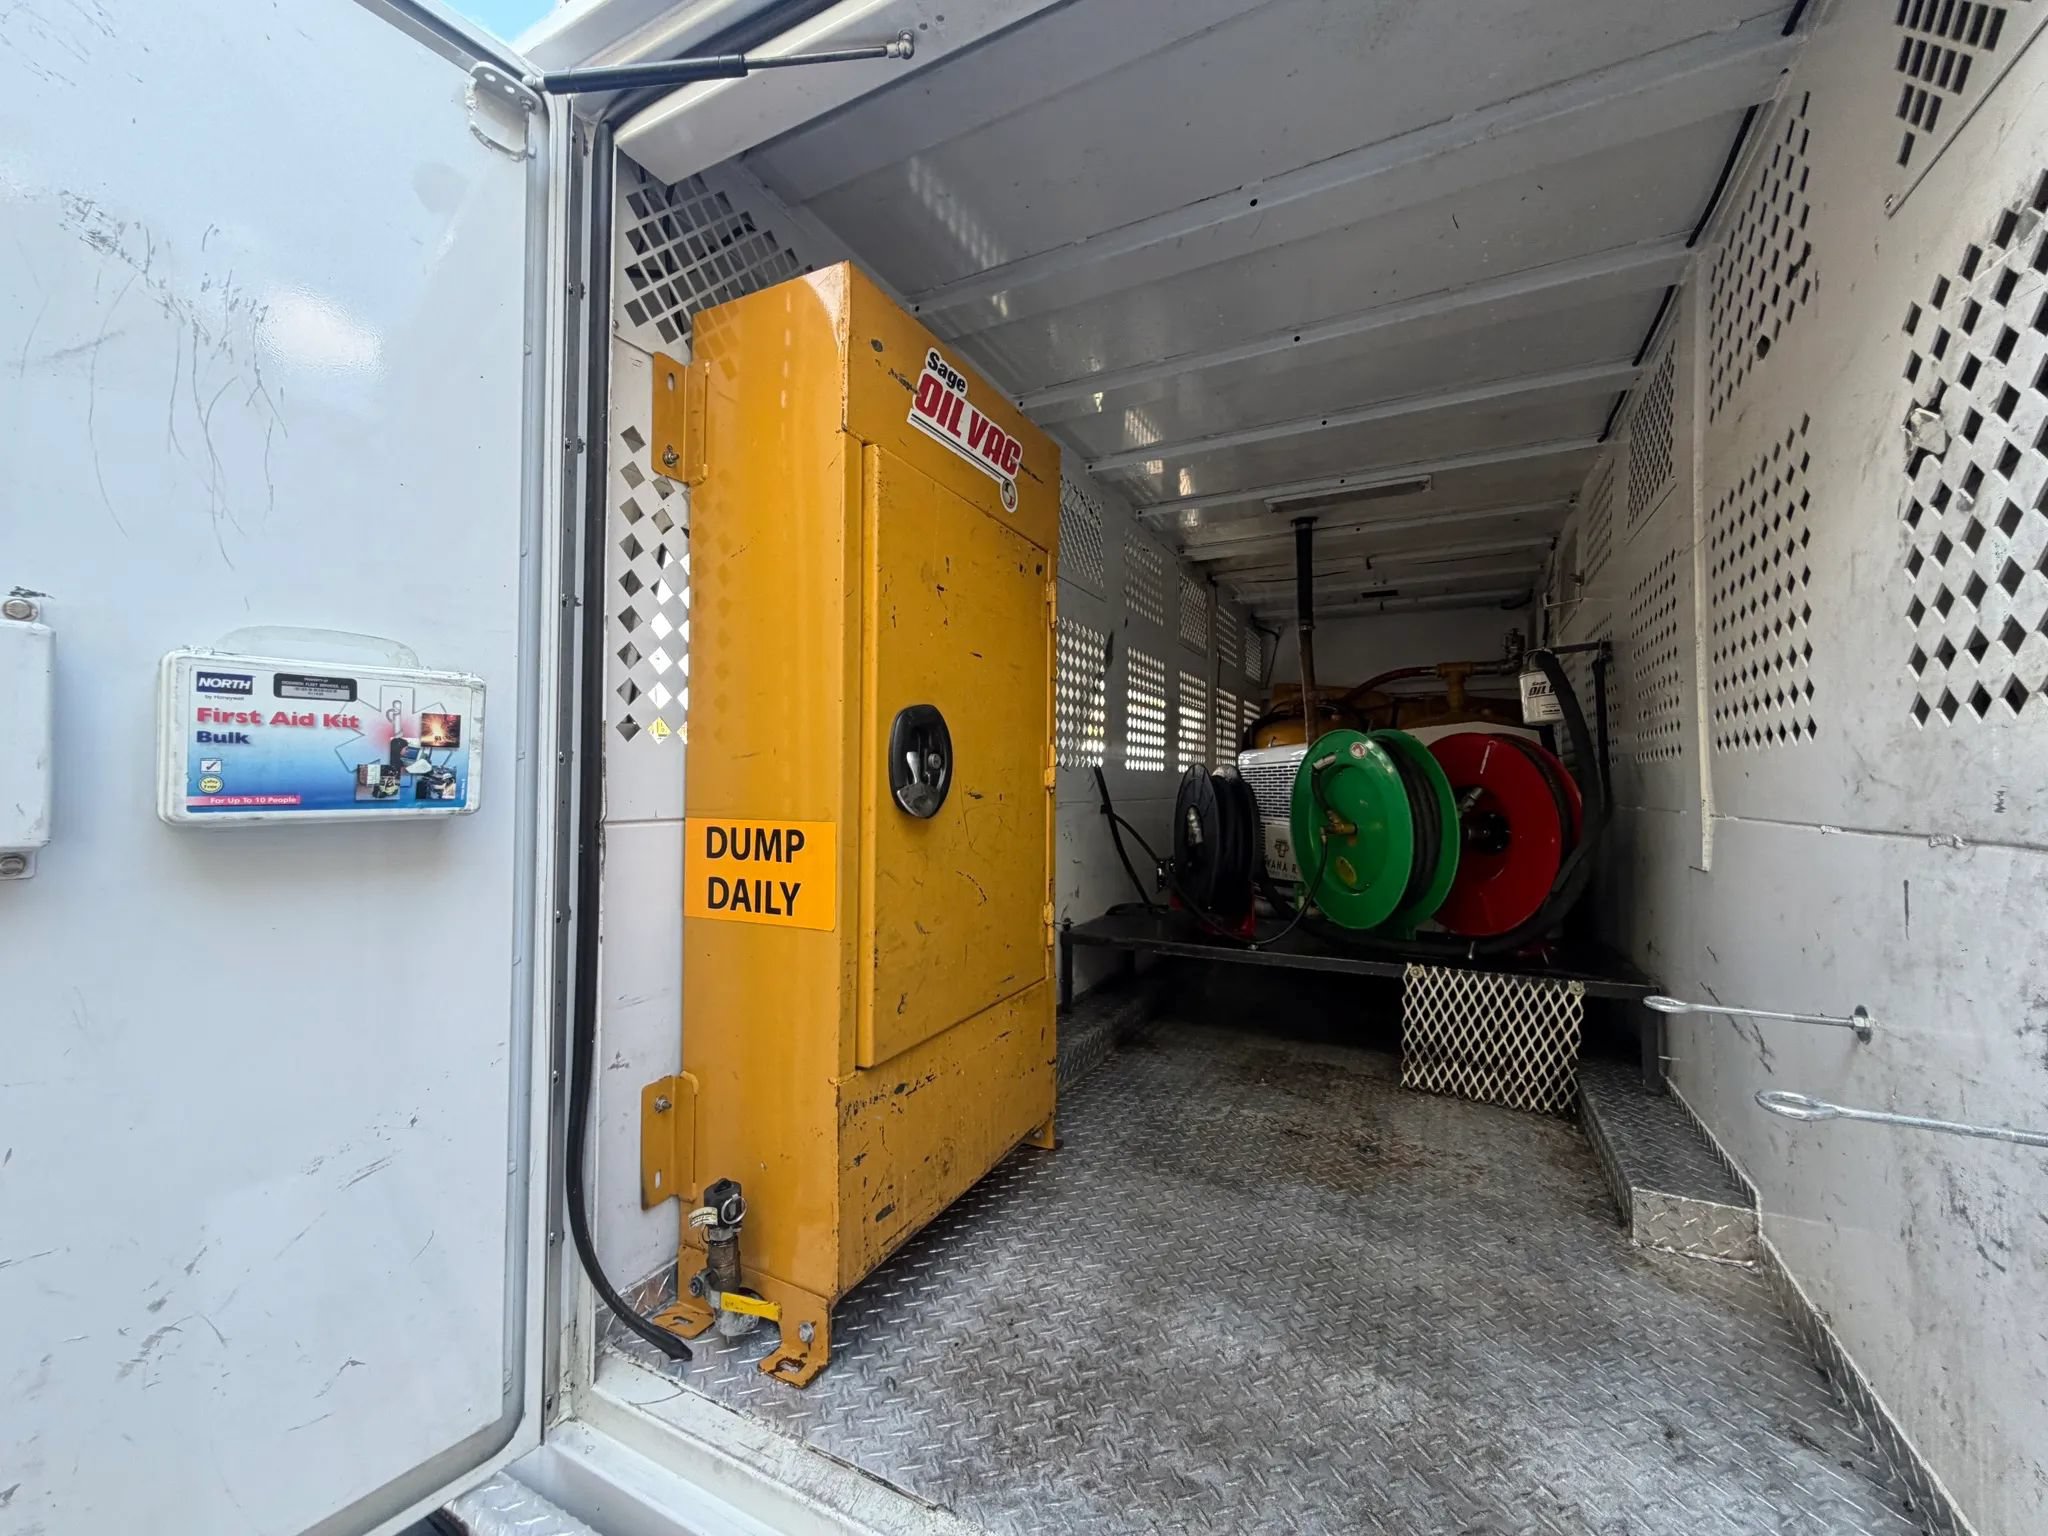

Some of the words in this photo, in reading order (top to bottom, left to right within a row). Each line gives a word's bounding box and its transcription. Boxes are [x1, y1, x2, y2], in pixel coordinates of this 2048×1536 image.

[927, 351, 966, 393] Sage
[914, 373, 965, 439] OIL
[967, 409, 1022, 476] VAC
[198, 677, 251, 690] NORTH
[1529, 685, 1546, 696] OIL
[196, 707, 262, 724] First
[270, 711, 315, 727] Aid
[323, 713, 360, 729] Kit
[196, 731, 250, 745] Bulk
[227, 797, 240, 806] Up
[267, 796, 297, 805] People
[706, 826, 805, 863] DUMP
[707, 876, 802, 917] DAILY
